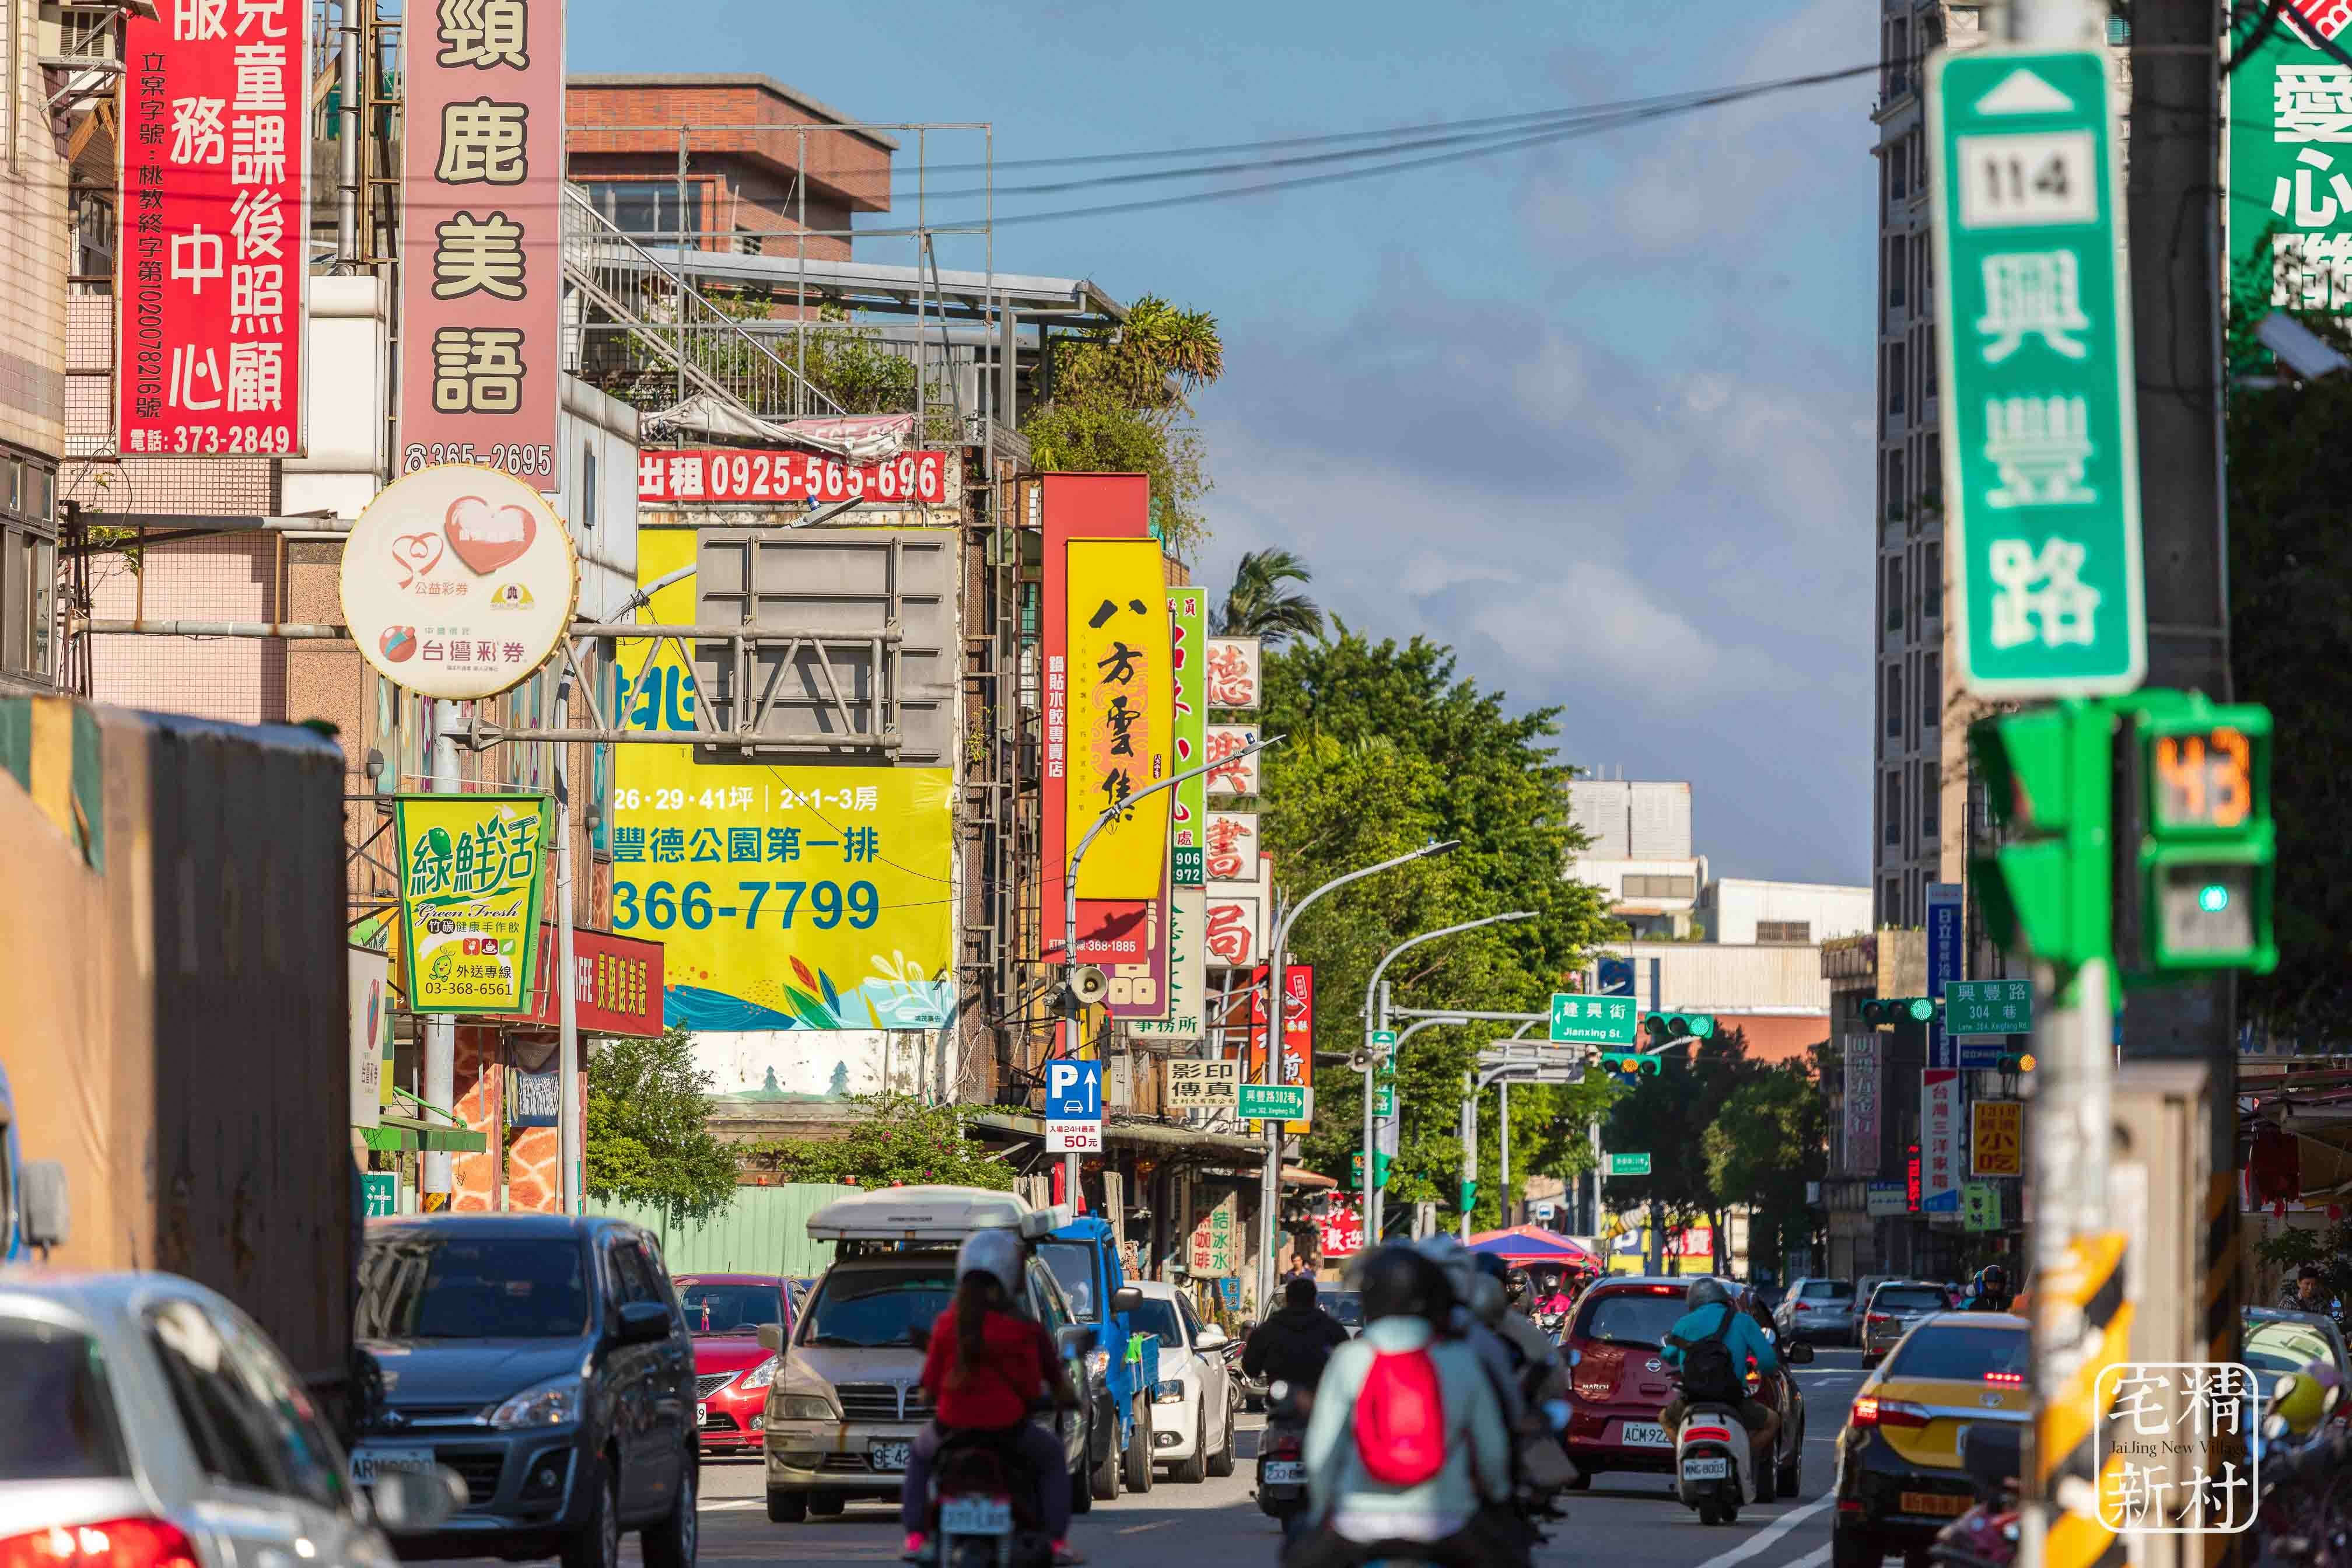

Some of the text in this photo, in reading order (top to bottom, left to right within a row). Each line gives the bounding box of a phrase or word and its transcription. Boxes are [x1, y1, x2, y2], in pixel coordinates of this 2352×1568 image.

[174, 426, 289, 454] 373-2849
[422, 639, 525, 663] 台灣彩券
[2157, 727, 2250, 828] 43
[614, 826, 879, 864] 豐德公園第一排
[1176, 853, 1200, 864] 906
[1176, 869, 1200, 881] 972
[417, 900, 523, 927] Green Fresh
[613, 881, 880, 930] 366-7799
[457, 964, 512, 980] 外送專線
[425, 982, 513, 996] 03-368-6561
[1957, 984, 2026, 1002] 興豐路
[1563, 1001, 1626, 1020] 建興街
[1563, 1027, 1623, 1038] Jianxing St.
[1172, 1063, 1233, 1079] 影印
[1051, 1065, 1079, 1099] P
[1172, 1082, 1234, 1097] 傳真
